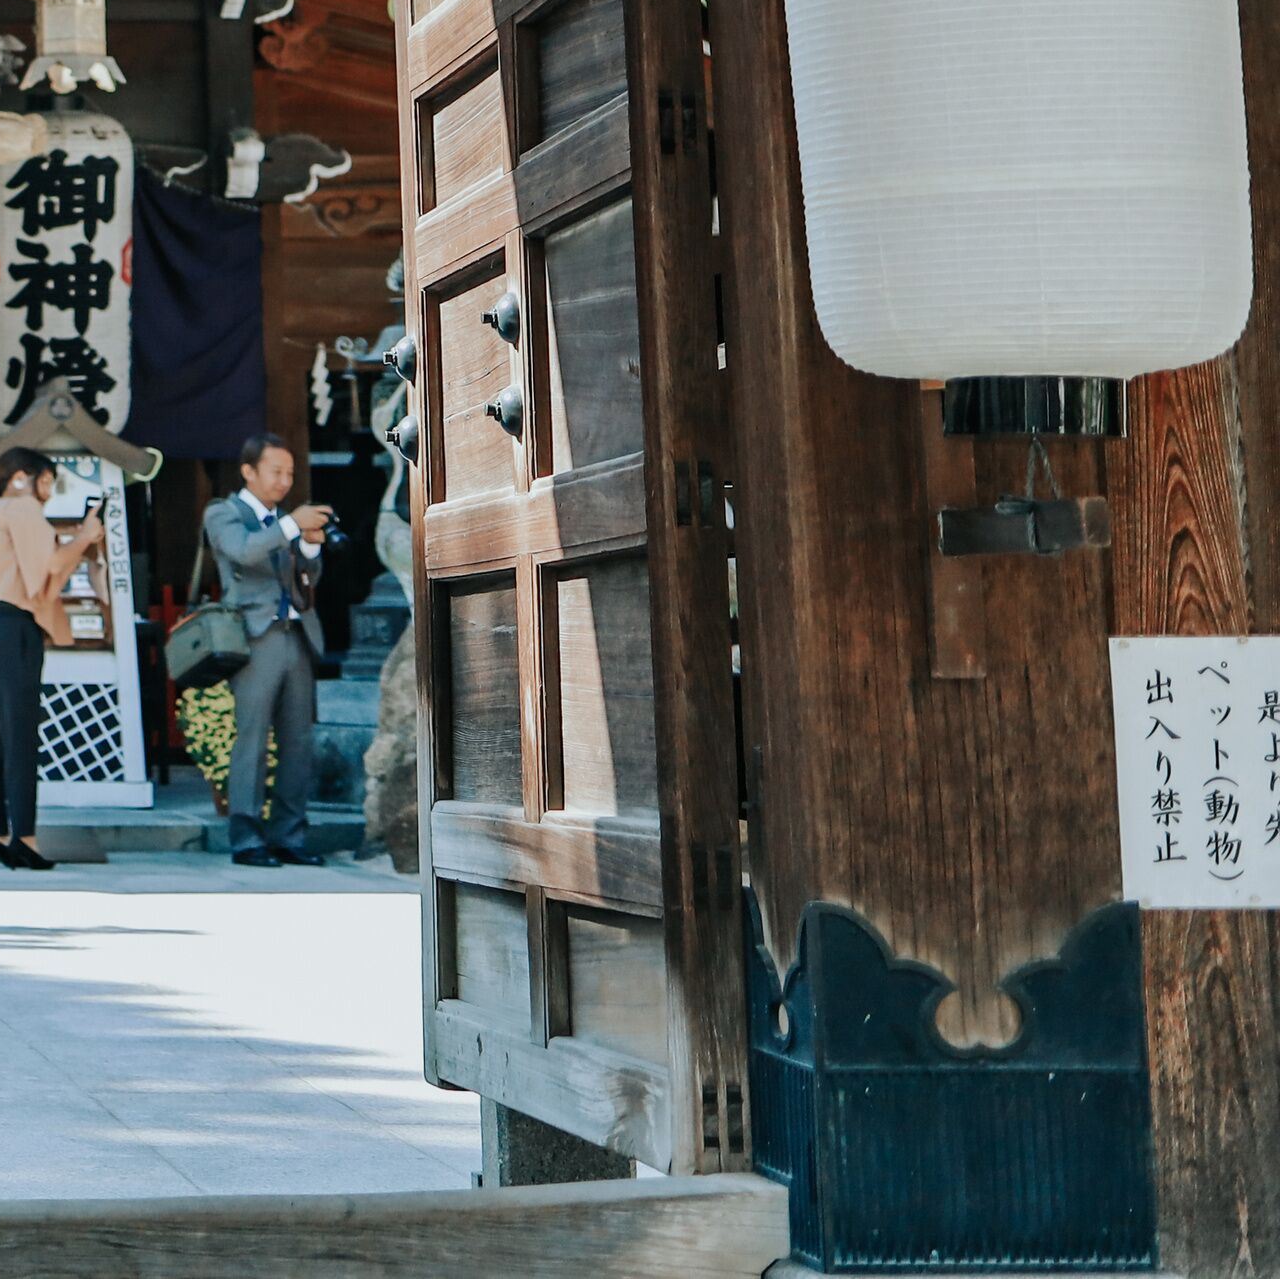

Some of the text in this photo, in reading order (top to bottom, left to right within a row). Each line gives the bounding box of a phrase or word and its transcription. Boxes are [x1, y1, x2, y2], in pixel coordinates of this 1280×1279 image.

[1145, 669, 1187, 863] 出入り禁止
